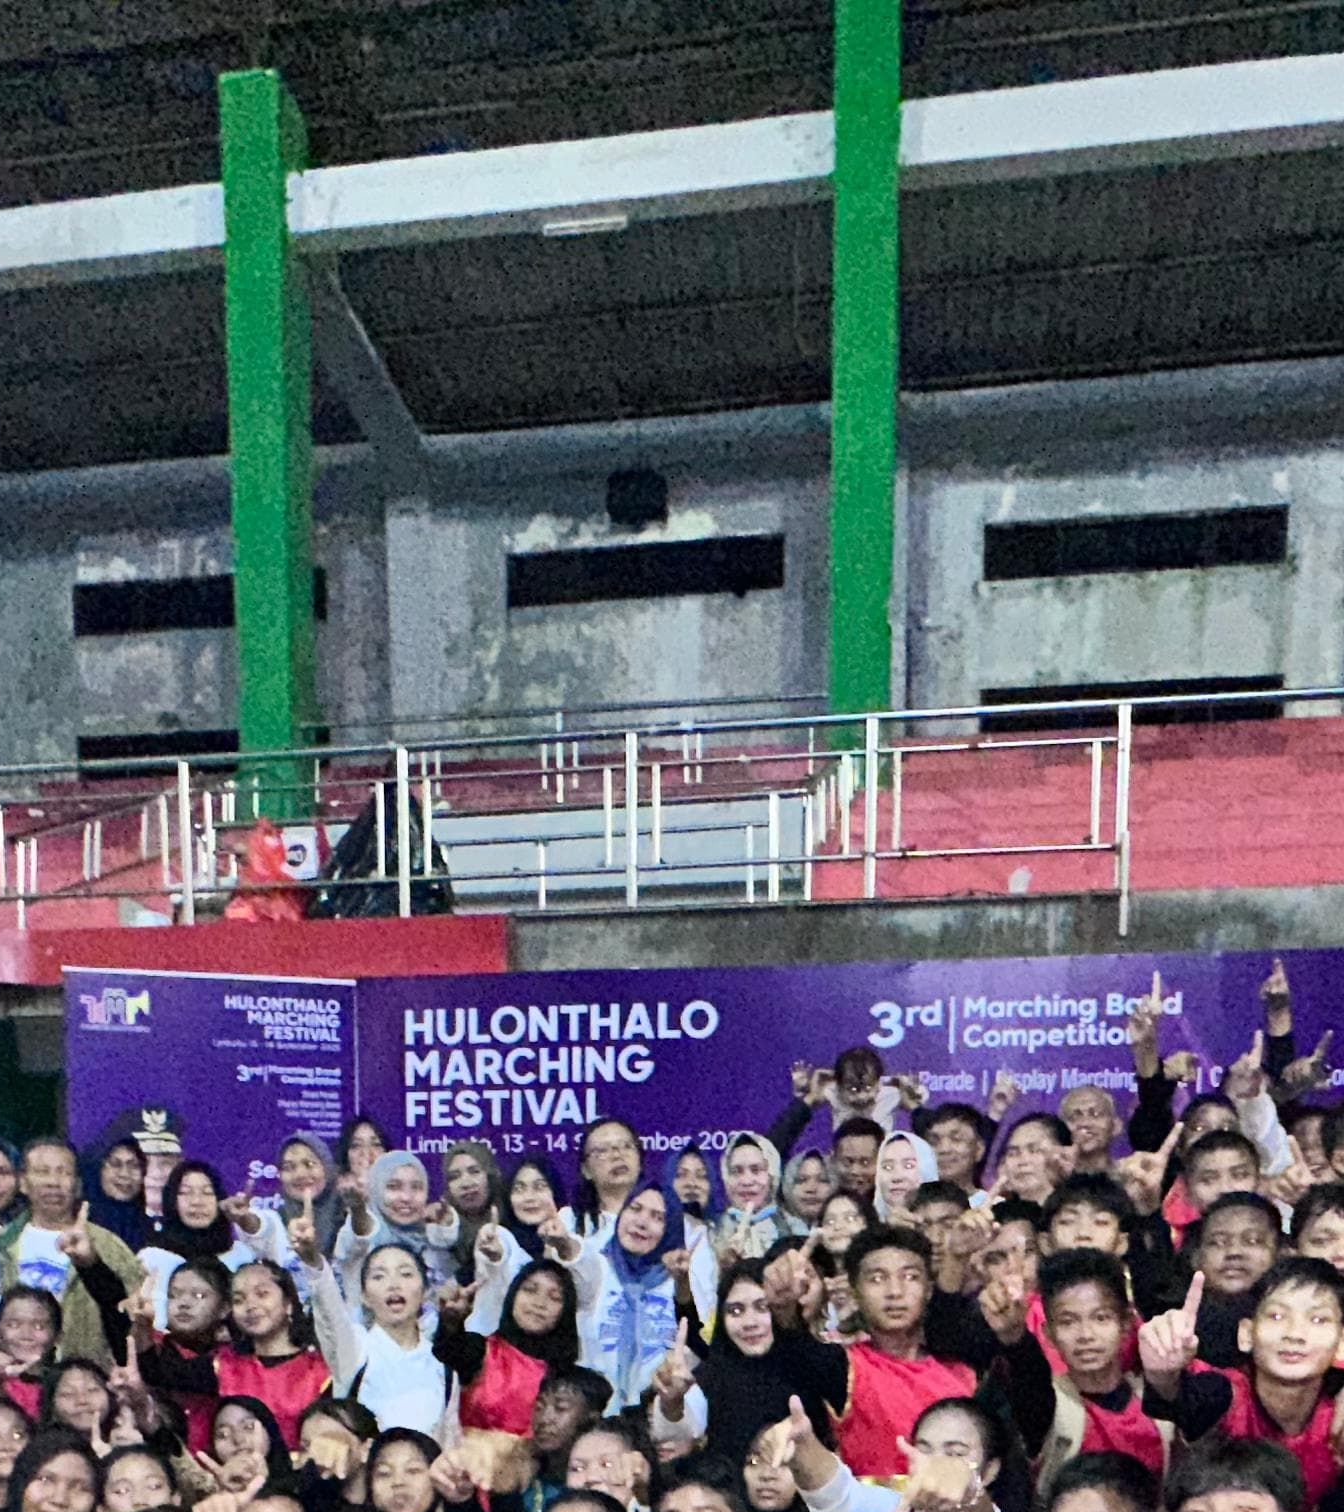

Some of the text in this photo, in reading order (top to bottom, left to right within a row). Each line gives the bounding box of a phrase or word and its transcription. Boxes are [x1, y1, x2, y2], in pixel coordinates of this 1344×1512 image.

[223, 994, 341, 1014] HULONTHALO
[247, 1010, 341, 1028] MARCHING
[404, 1000, 719, 1045] HULONTHALO
[867, 991, 1183, 1048] 3rd Marching Bad
[263, 1025, 341, 1042] FESTIVAL
[405, 1044, 655, 1087] MARCHING
[918, 1069, 975, 1092] Parade
[997, 1067, 1058, 1095] splay
[1060, 1067, 1138, 1093] Marching
[405, 1088, 604, 1128] FESTIVAL
[502, 1133, 523, 1153] 13
[544, 1133, 568, 1153] 14
